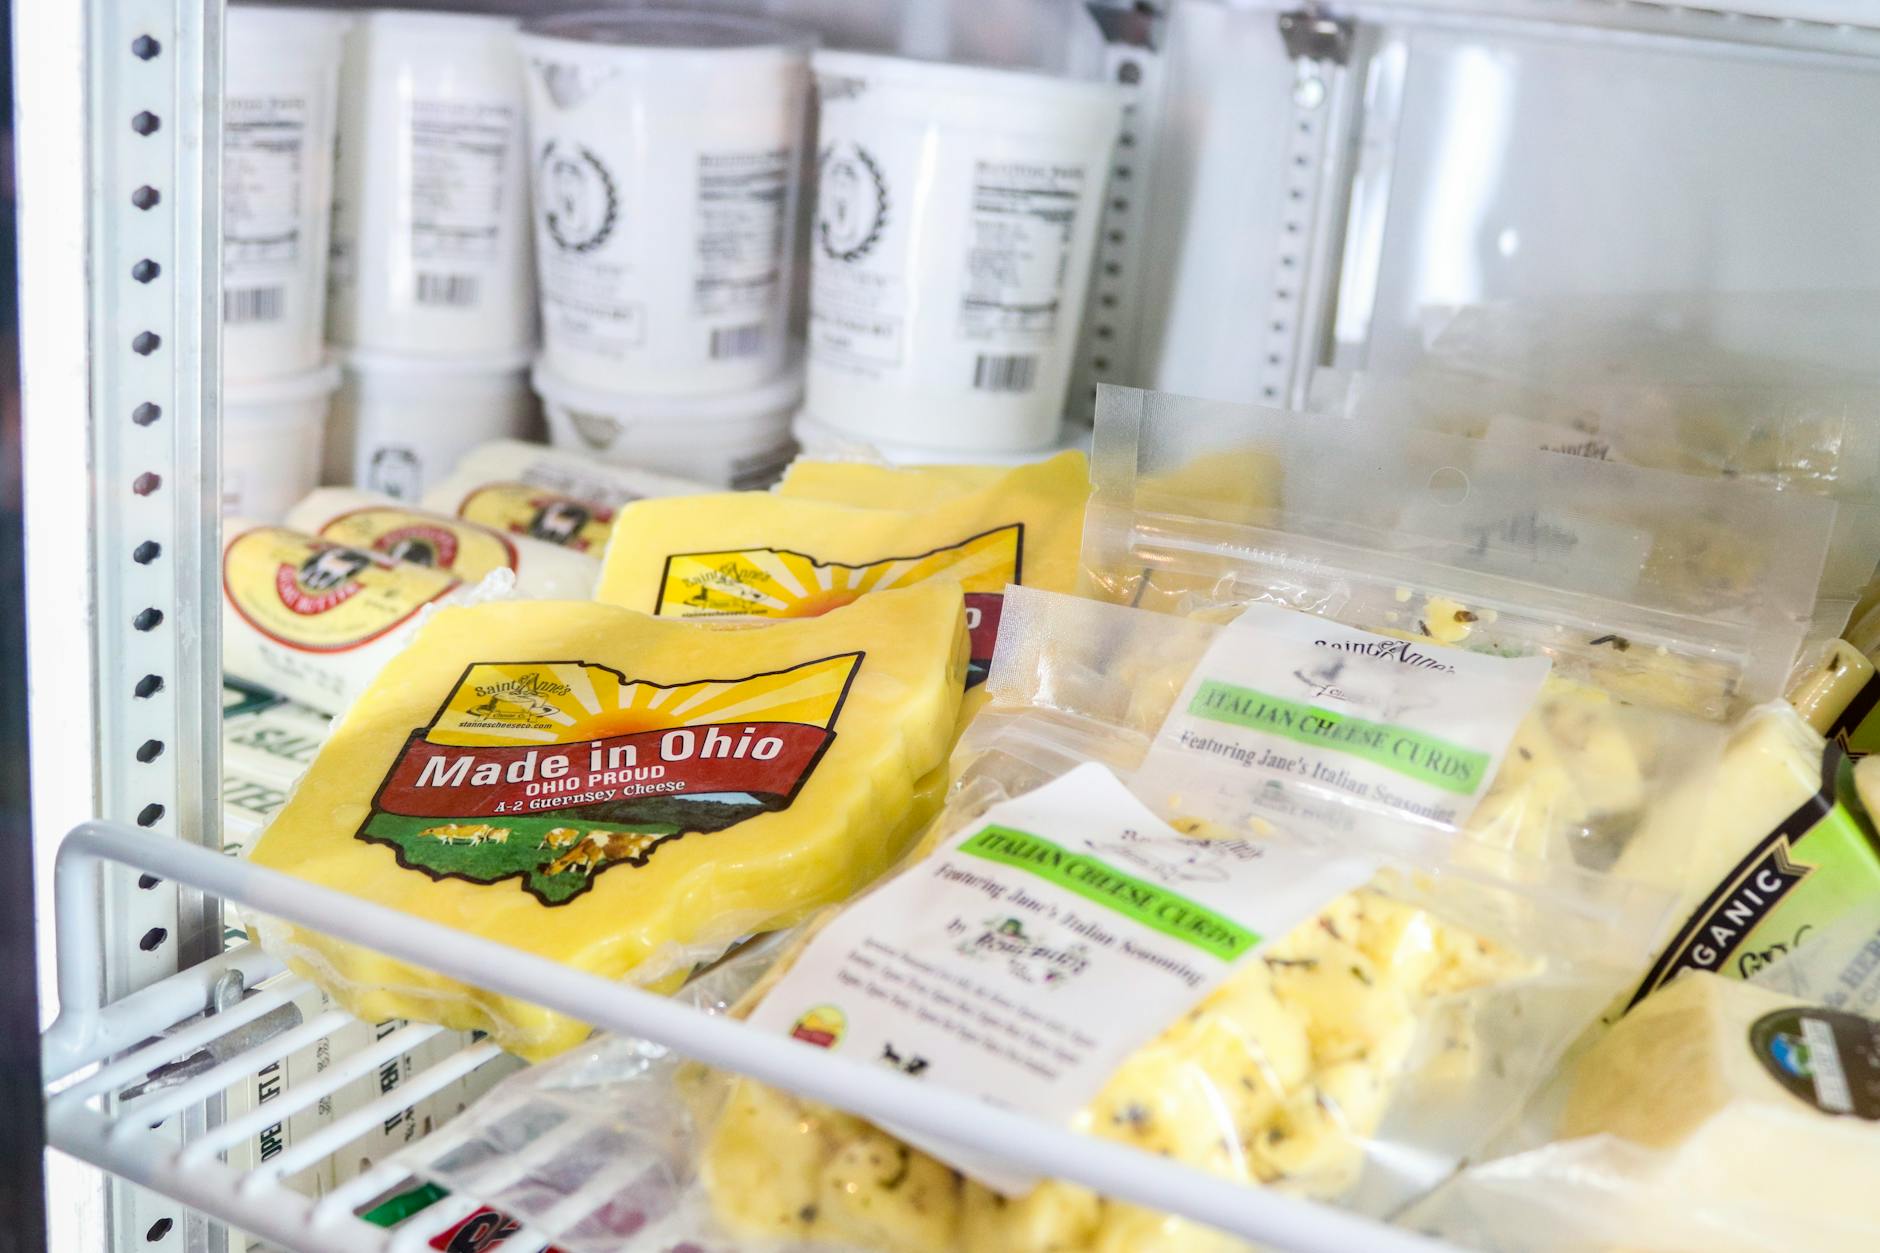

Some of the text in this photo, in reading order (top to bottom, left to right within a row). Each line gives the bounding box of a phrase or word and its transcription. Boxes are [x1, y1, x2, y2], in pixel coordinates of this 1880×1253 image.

[475, 672, 572, 698] Saint Anne's
[458, 721, 553, 730] stannescheeseco.com
[1203, 688, 1474, 782] ITALIAN CHEESE CURDS
[415, 727, 785, 788] Made in Ohio
[525, 765, 666, 798] OHIO PROUD
[1180, 729, 1257, 766] Featuring
[1257, 748, 1309, 776] Jane's
[1311, 761, 1369, 796] Italian
[493, 778, 686, 814] A-2 Guernsey Cheese
[976, 831, 1064, 870] ITALIAN
[1063, 858, 1155, 912] CHEESE
[1155, 900, 1241, 950] CURDS
[1681, 869, 1783, 974] GANIC
